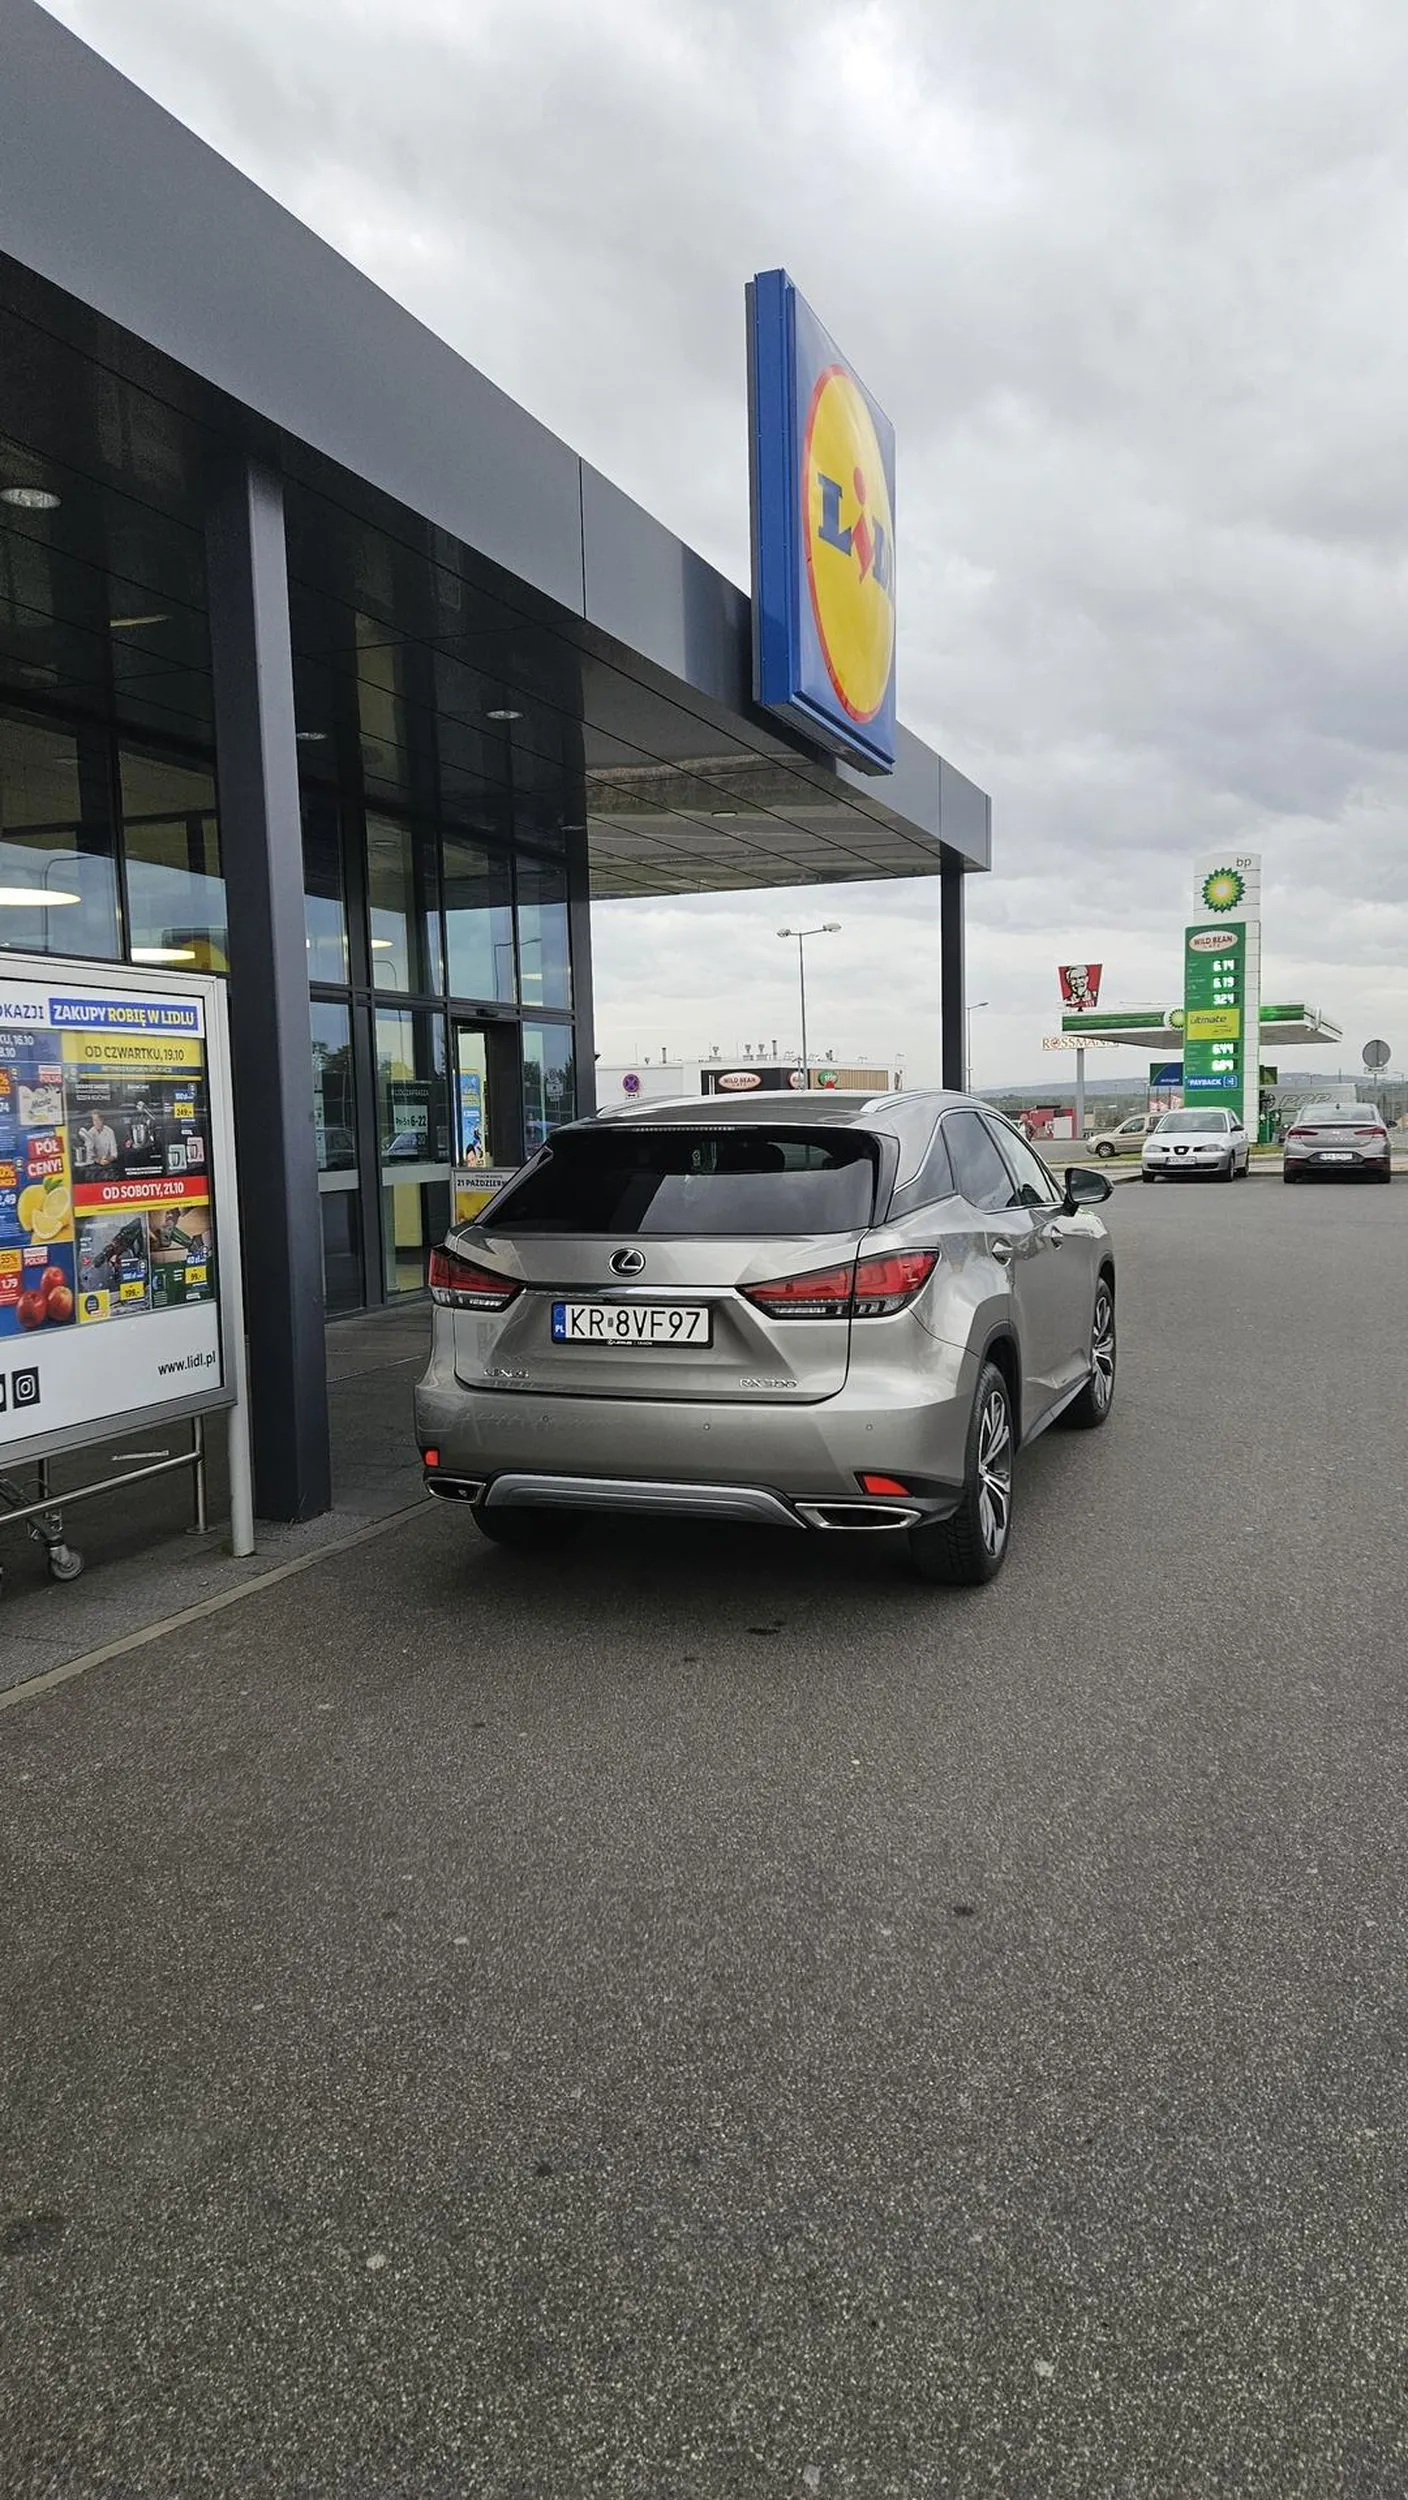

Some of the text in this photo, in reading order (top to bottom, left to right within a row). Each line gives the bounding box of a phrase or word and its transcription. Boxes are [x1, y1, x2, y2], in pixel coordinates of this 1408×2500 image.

[1236, 857, 1251, 868] bp
[1213, 935, 1233, 943] BEAN
[53, 1005, 194, 1027] ZAKUPY ROBIĘ W LIDLU
[85, 1046, 184, 1061] OD CZWARTKU, 19.10
[1190, 1078, 1222, 1086] PAYBACK
[35, 1138, 60, 1155] PÓŁ
[27, 1159, 63, 1176] CENY!
[102, 1182, 184, 1200] OD SOBOTY, 21.10
[555, 1324, 564, 1333] PL
[571, 1308, 701, 1339] KR 8VF97
[158, 1350, 216, 1376] www.lidl.pl
